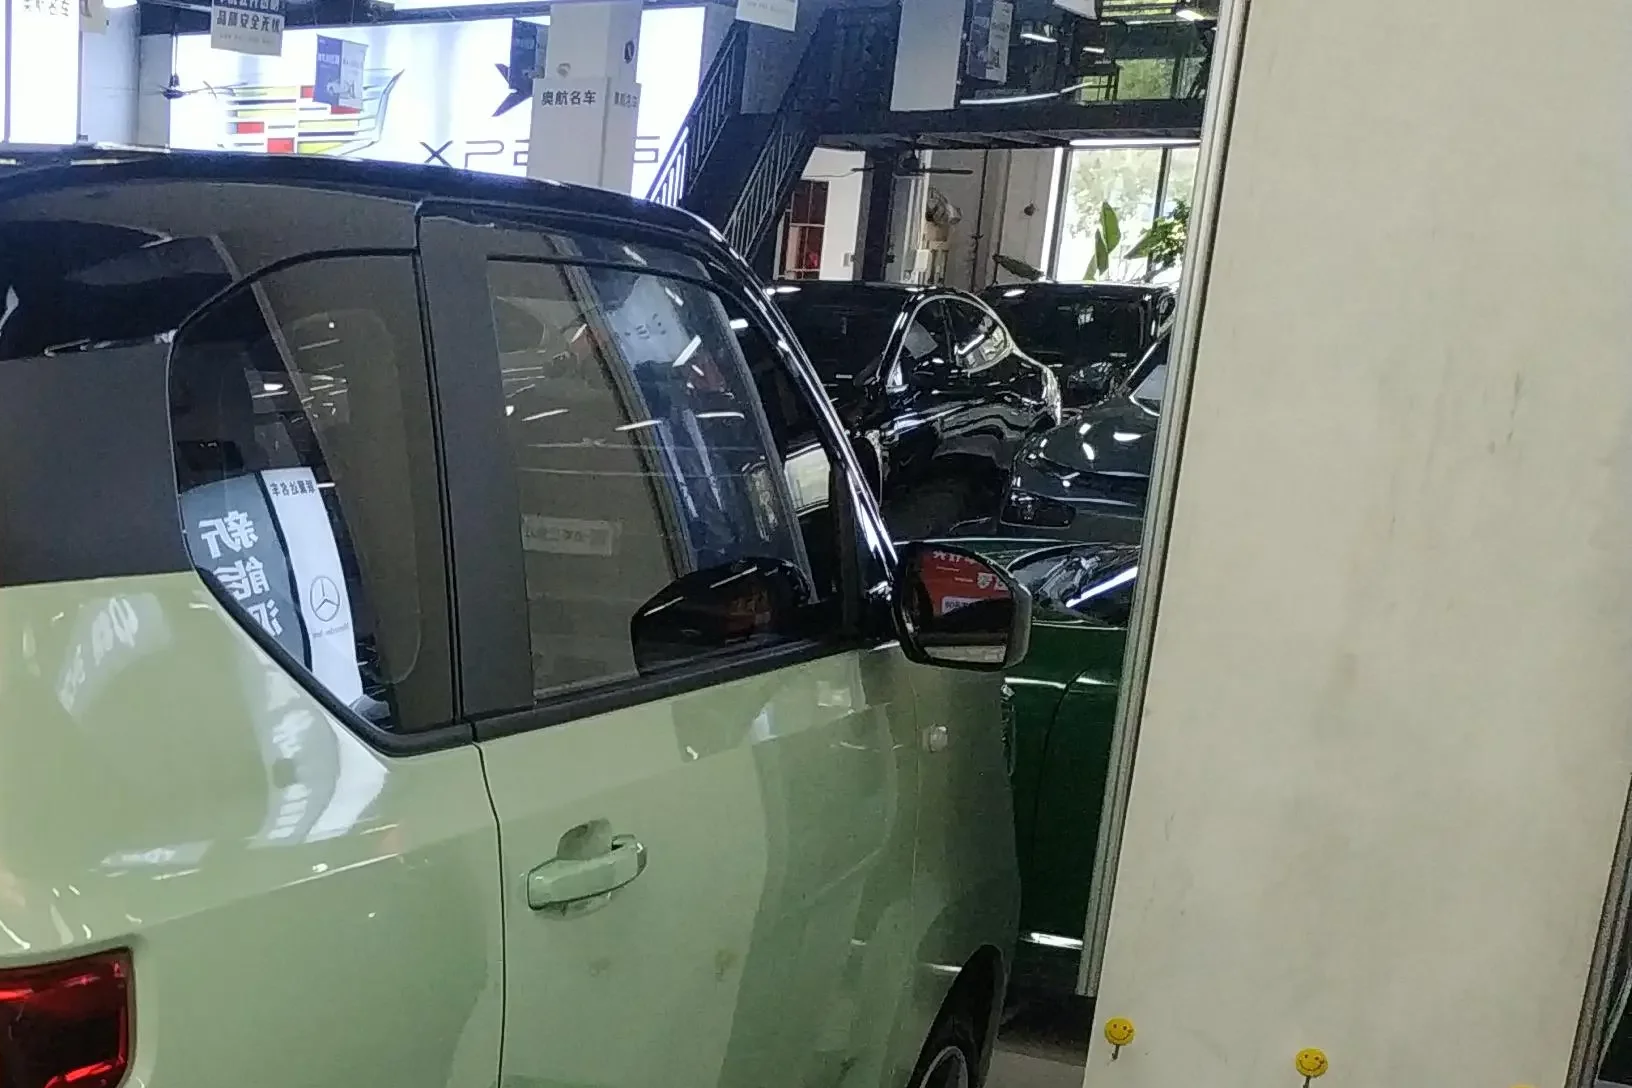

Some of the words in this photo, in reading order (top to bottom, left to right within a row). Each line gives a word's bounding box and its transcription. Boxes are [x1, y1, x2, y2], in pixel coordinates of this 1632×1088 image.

[540, 89, 597, 106] 奥航名车
[419, 135, 661, 170] XPG
